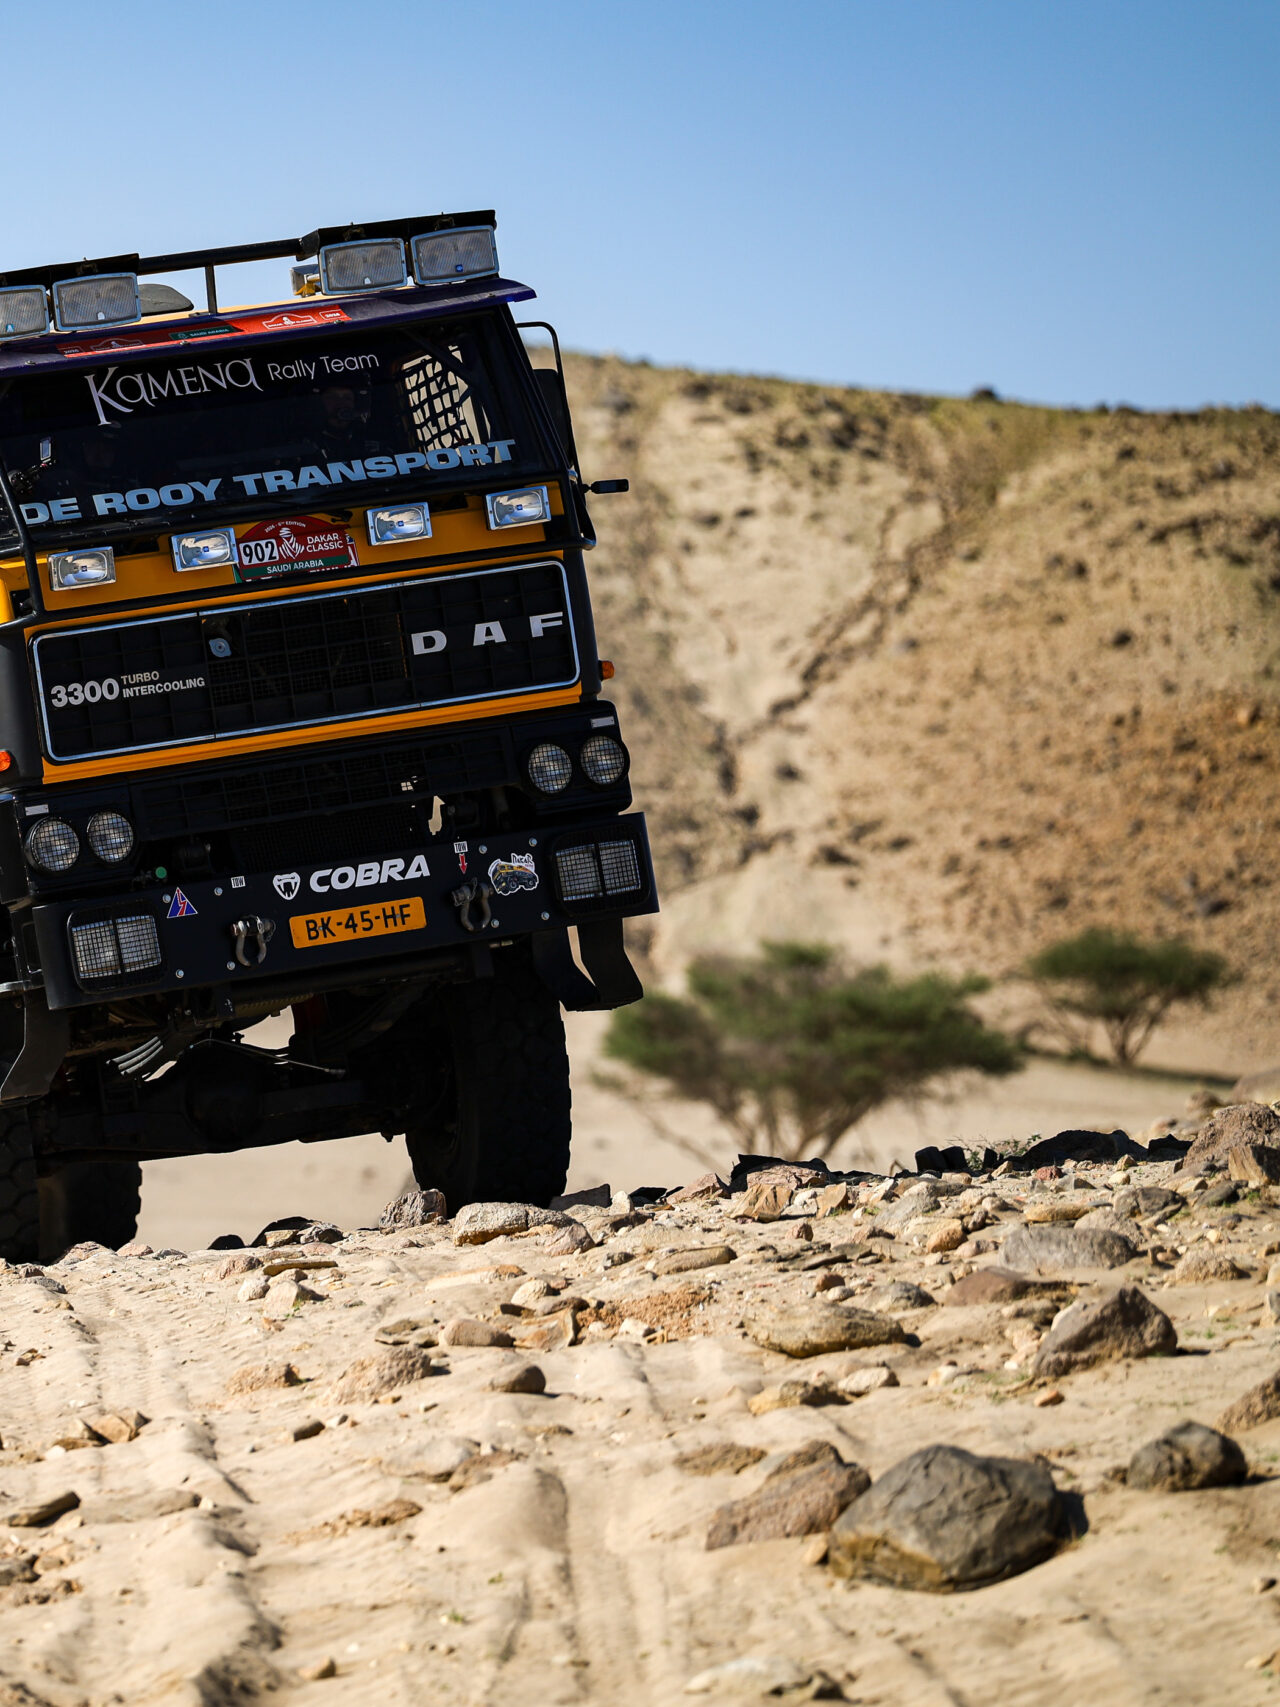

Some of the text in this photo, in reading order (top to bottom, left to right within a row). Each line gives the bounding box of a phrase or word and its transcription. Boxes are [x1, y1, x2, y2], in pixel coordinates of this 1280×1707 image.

[268, 360, 317, 383] Rally
[319, 352, 380, 376] Team
[20, 440, 517, 526] DE ROOY TRANSPORT
[306, 533, 339, 545] DAKAR
[306, 541, 344, 553] CLASSIC
[242, 540, 277, 564] 902
[266, 559, 324, 574] SAUDI ARABIA
[50, 671, 160, 708] 3300 TURBO
[122, 677, 205, 698] INTERCOOLING
[454, 842, 467, 852] TOW
[231, 877, 245, 887] TOW
[309, 855, 431, 893] COBRA
[305, 903, 411, 941] BK-45-HF
